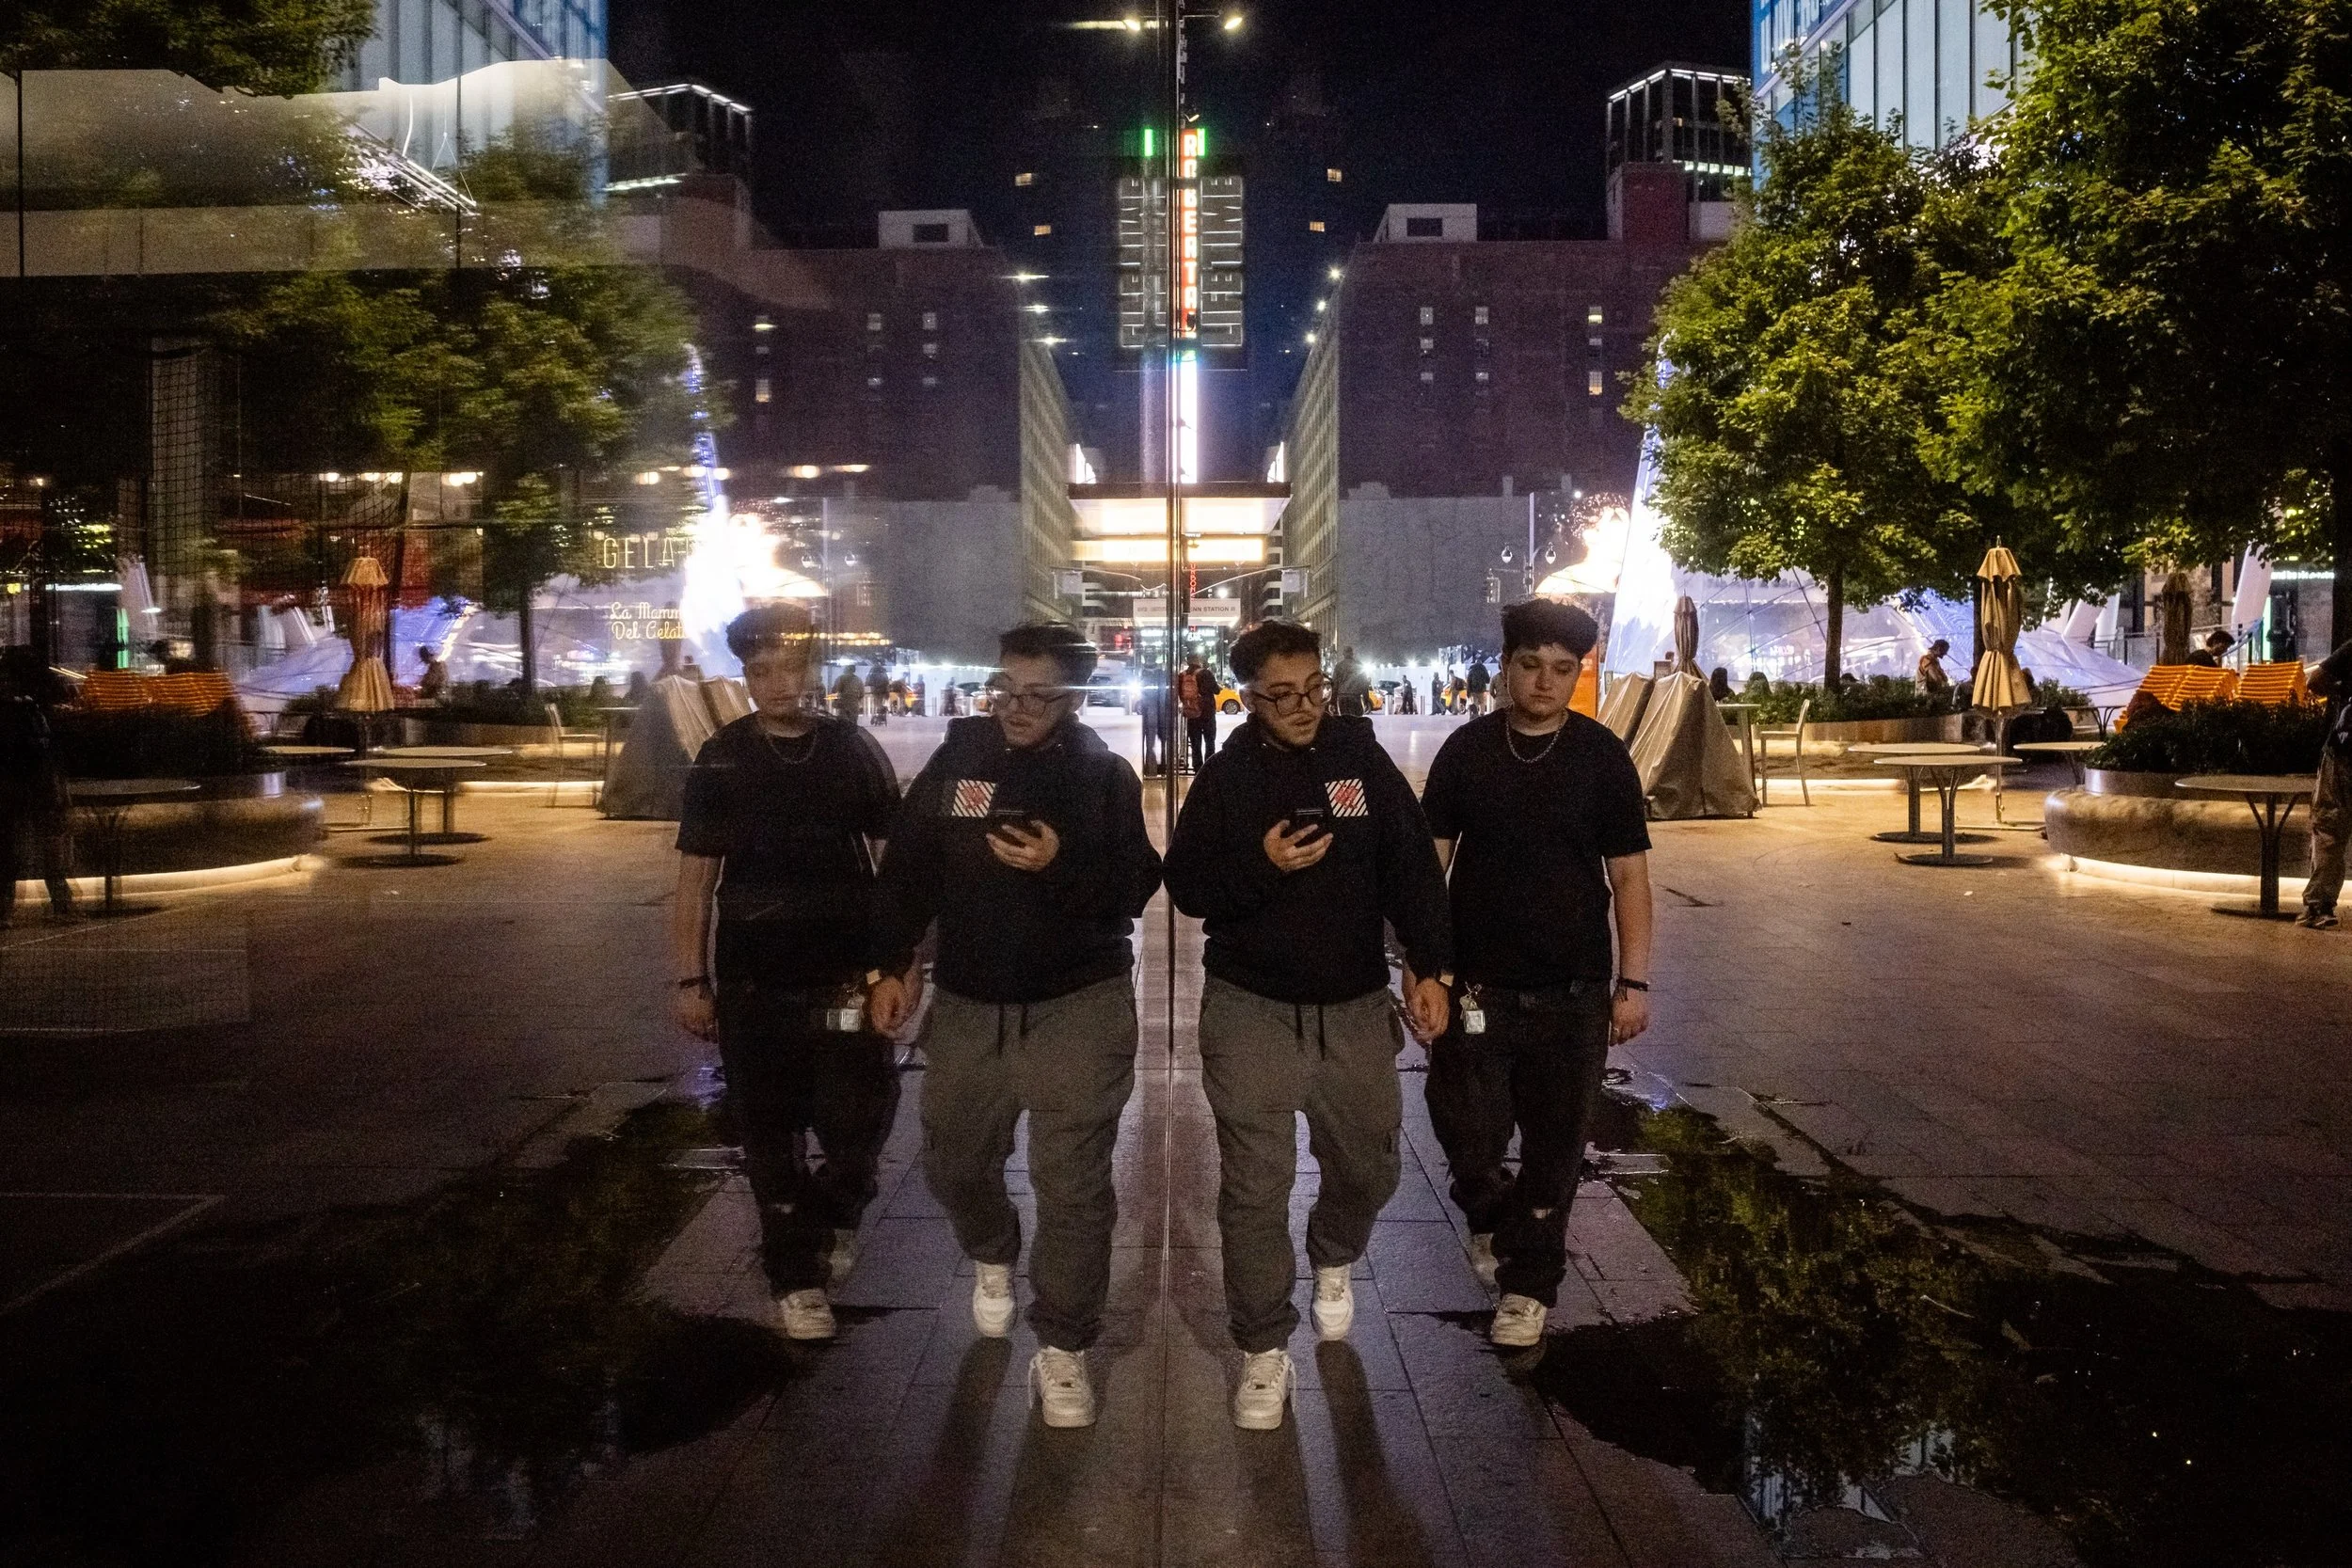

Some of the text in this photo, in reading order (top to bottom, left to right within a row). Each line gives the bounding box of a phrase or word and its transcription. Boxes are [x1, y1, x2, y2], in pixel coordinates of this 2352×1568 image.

[603, 536, 691, 569] GELAT
[610, 601, 683, 620] La Mamm
[612, 620, 687, 640] Del Gelat
